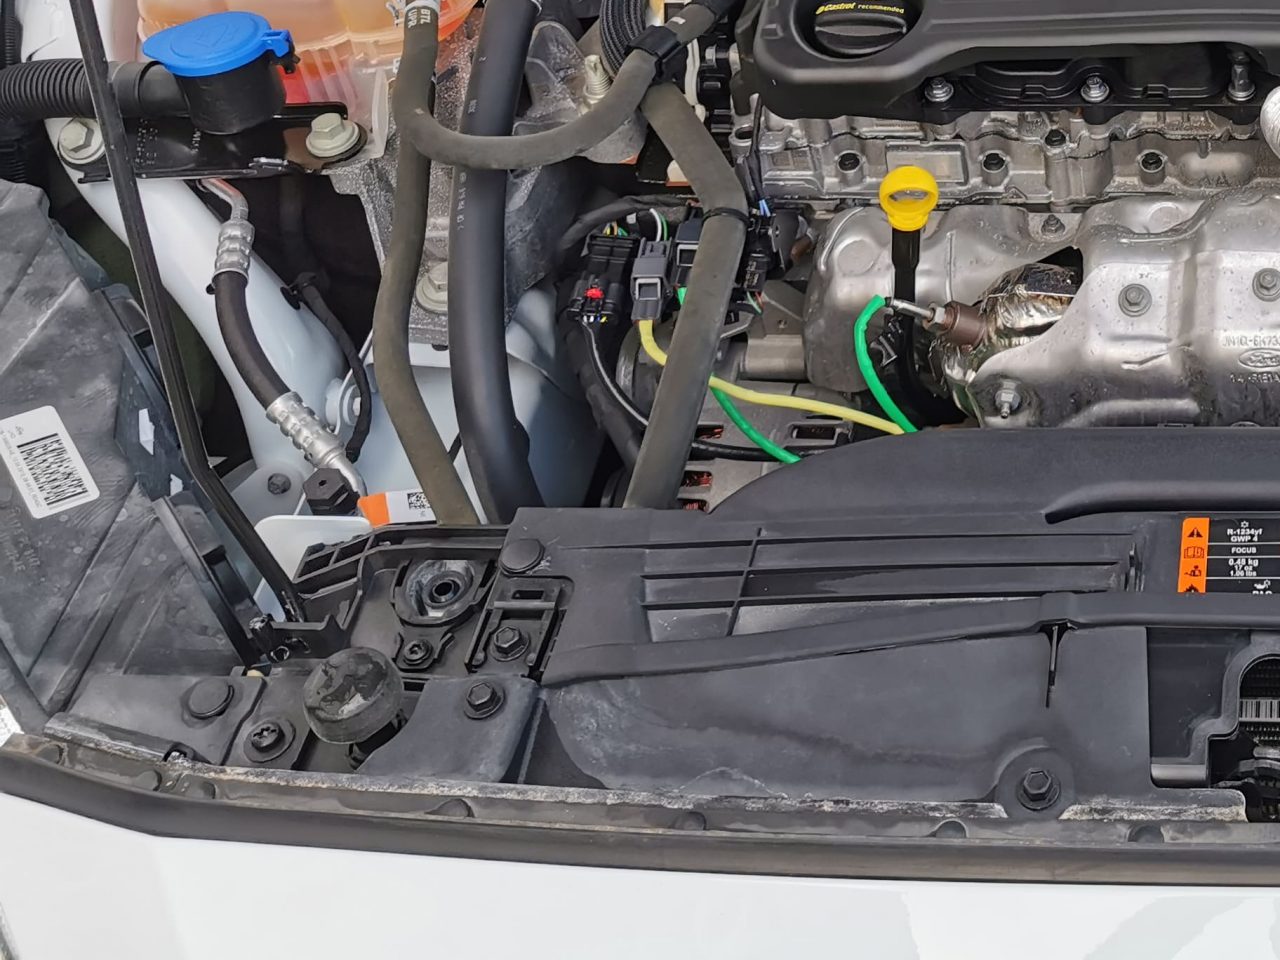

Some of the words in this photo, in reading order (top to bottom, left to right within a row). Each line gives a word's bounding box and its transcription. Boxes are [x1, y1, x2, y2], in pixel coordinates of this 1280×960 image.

[824, 2, 856, 12] Castrol
[858, 4, 904, 14] recommended
[1226, 528, 1263, 537] R-1234yf
[1231, 546, 1257, 554] FOCUS
[1248, 558, 1259, 567] kg
